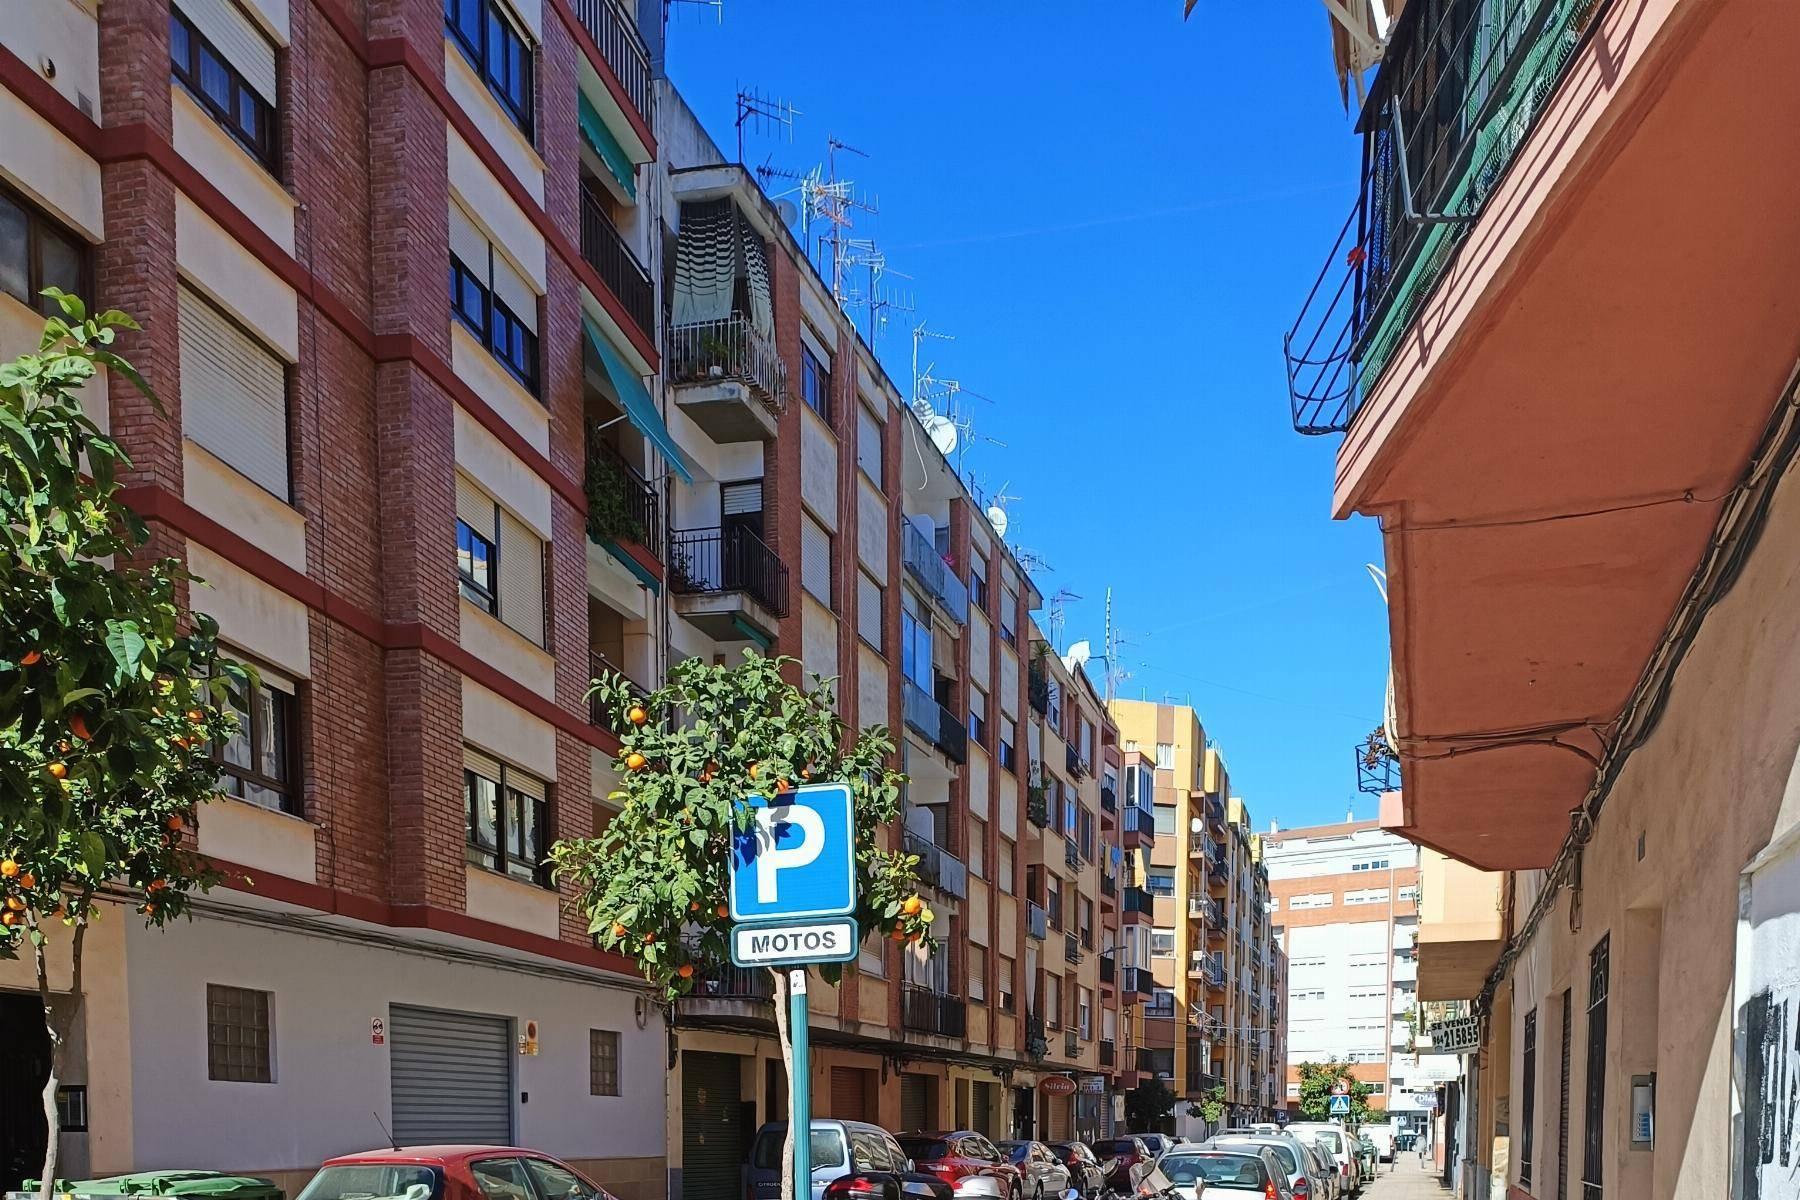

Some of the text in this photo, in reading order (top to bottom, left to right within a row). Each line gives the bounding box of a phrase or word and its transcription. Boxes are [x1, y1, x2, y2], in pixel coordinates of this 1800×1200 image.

[755, 804, 826, 904] P
[751, 930, 837, 954] MOTOS
[1431, 1016, 1476, 1031] SE VENDE
[1444, 1025, 1479, 1048] 215855
